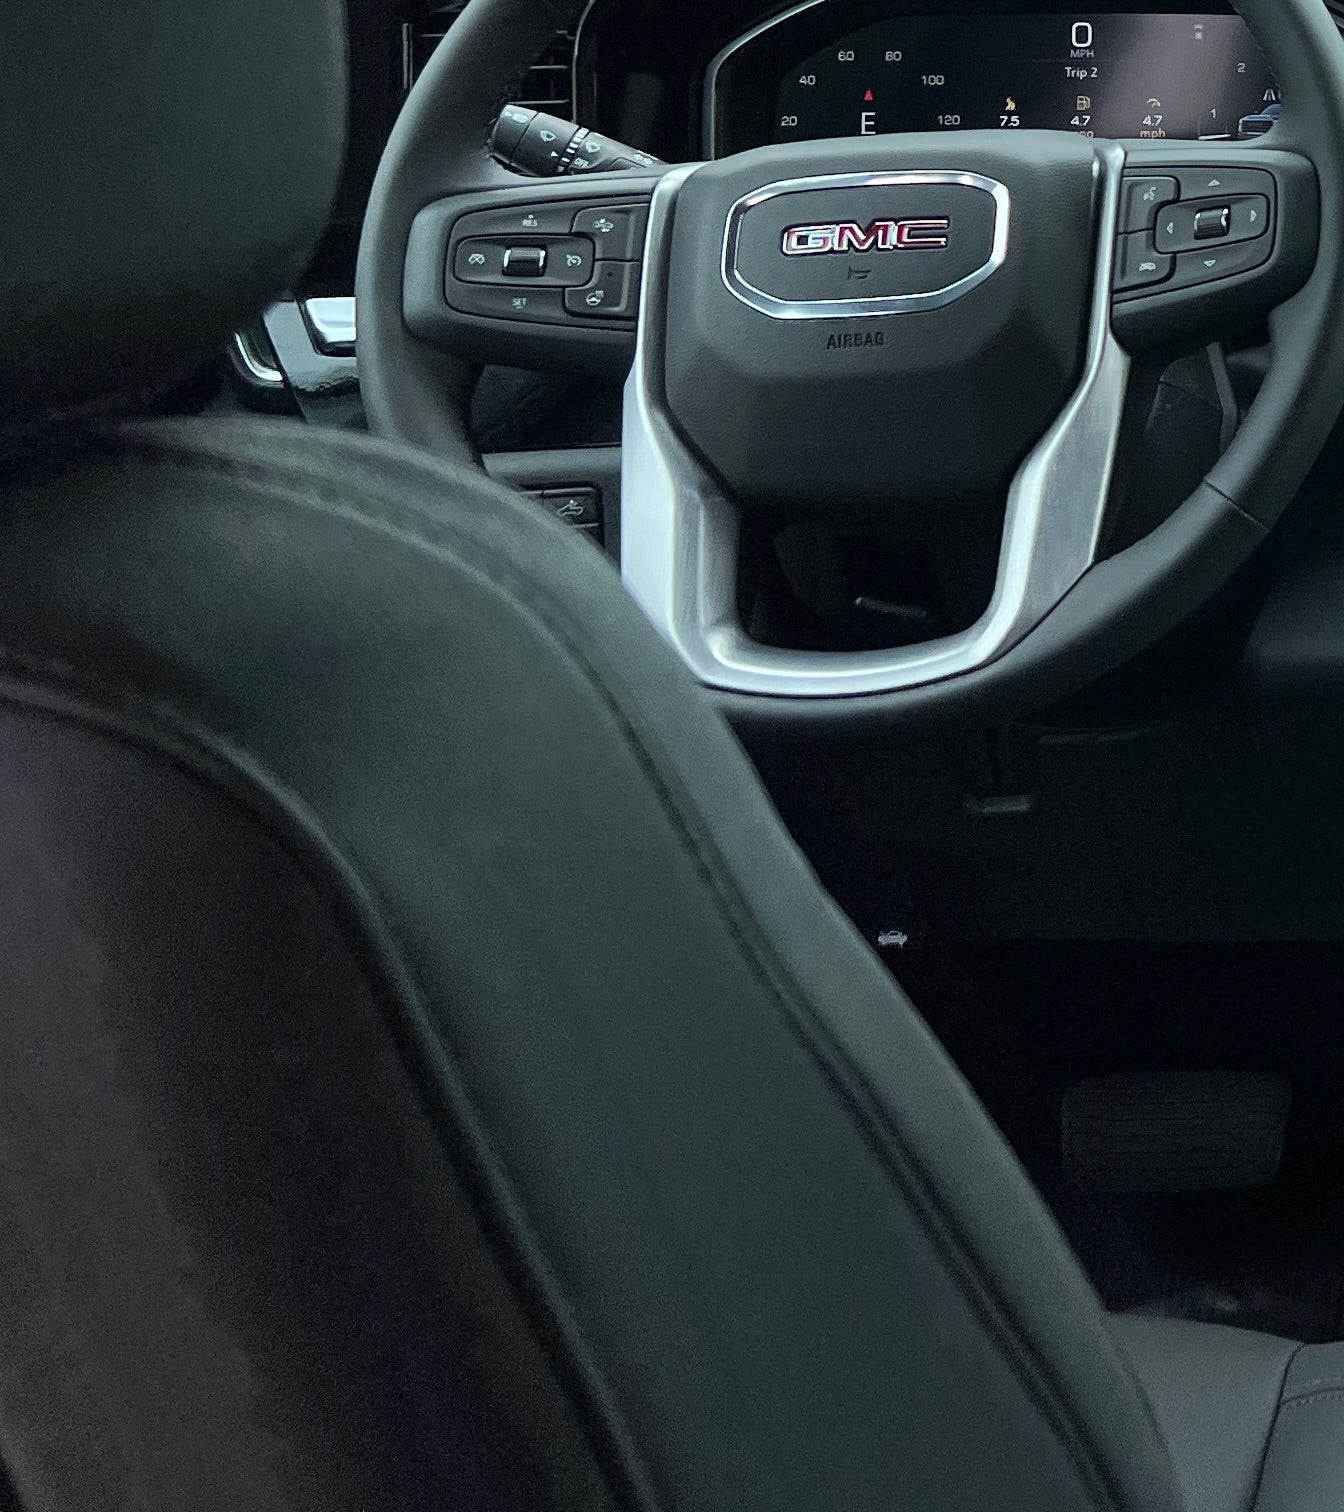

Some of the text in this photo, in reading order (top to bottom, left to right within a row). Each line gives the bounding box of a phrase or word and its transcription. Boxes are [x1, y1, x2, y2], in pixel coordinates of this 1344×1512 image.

[1071, 22, 1092, 47] 0
[837, 50, 855, 61] 60
[884, 50, 902, 61] 80
[1069, 49, 1094, 59] MPH
[1236, 62, 1246, 73] 2
[1065, 67, 1099, 80] Trip 2
[798, 75, 816, 85] 40
[920, 74, 945, 86] 100
[780, 116, 798, 126] 20
[861, 111, 877, 135] E
[937, 115, 961, 126] 120
[999, 115, 1020, 127] 7.5
[1070, 115, 1091, 126] 4.7
[1143, 115, 1164, 126] 4.7
[1139, 128, 1166, 140] mph
[783, 218, 950, 255] GMC
[825, 332, 885, 351] AIRBAG
